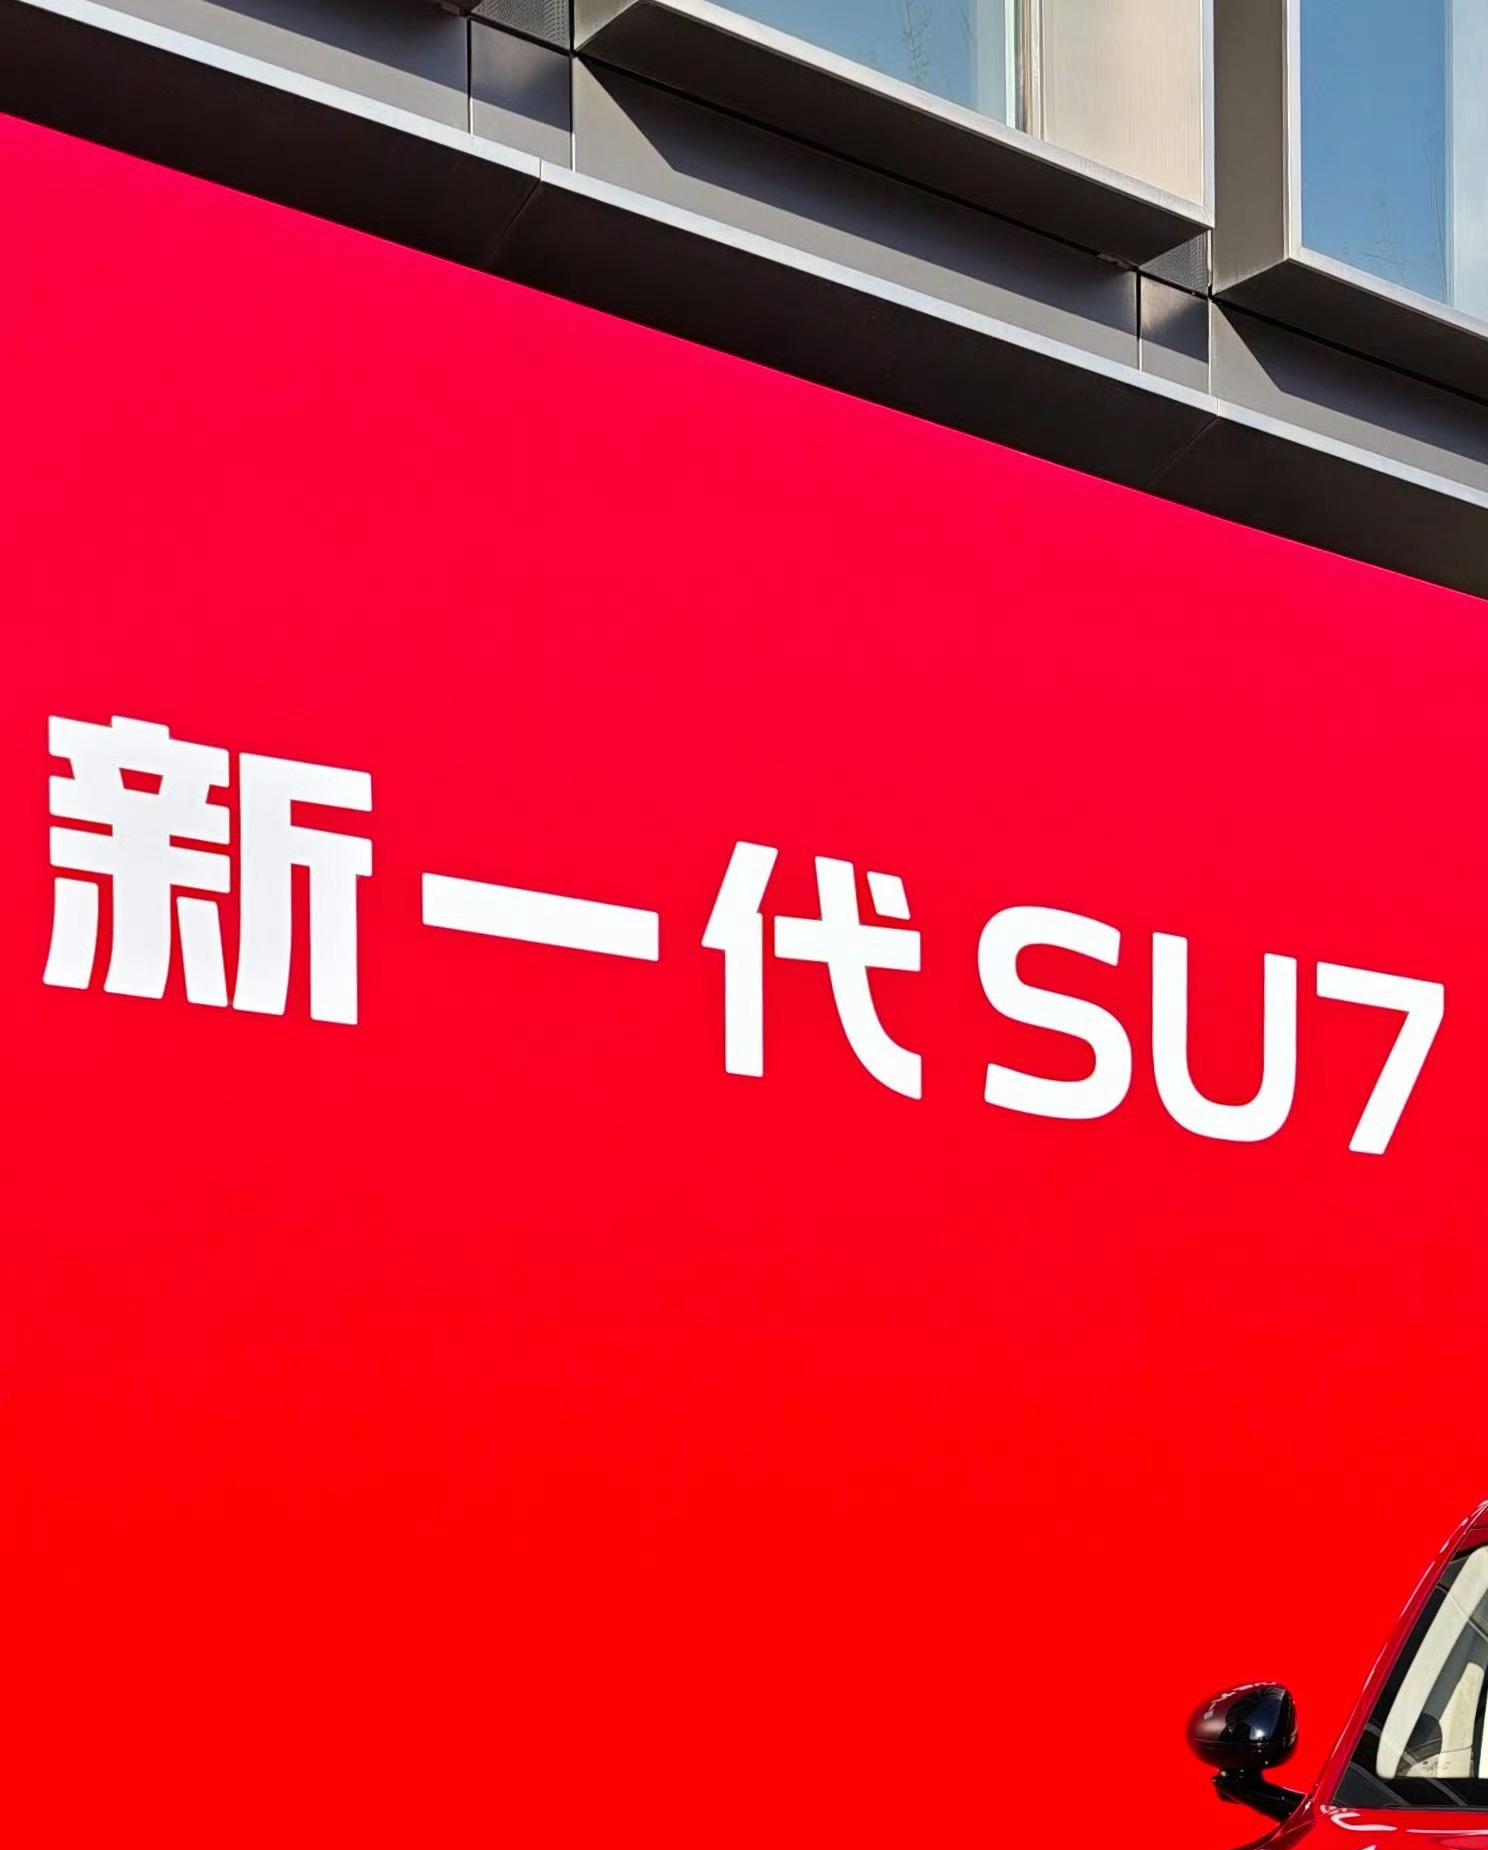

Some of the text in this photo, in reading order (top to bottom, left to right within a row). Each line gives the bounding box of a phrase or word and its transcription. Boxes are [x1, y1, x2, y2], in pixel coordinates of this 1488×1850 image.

[42, 715, 1445, 1155] 新一代 SU7
